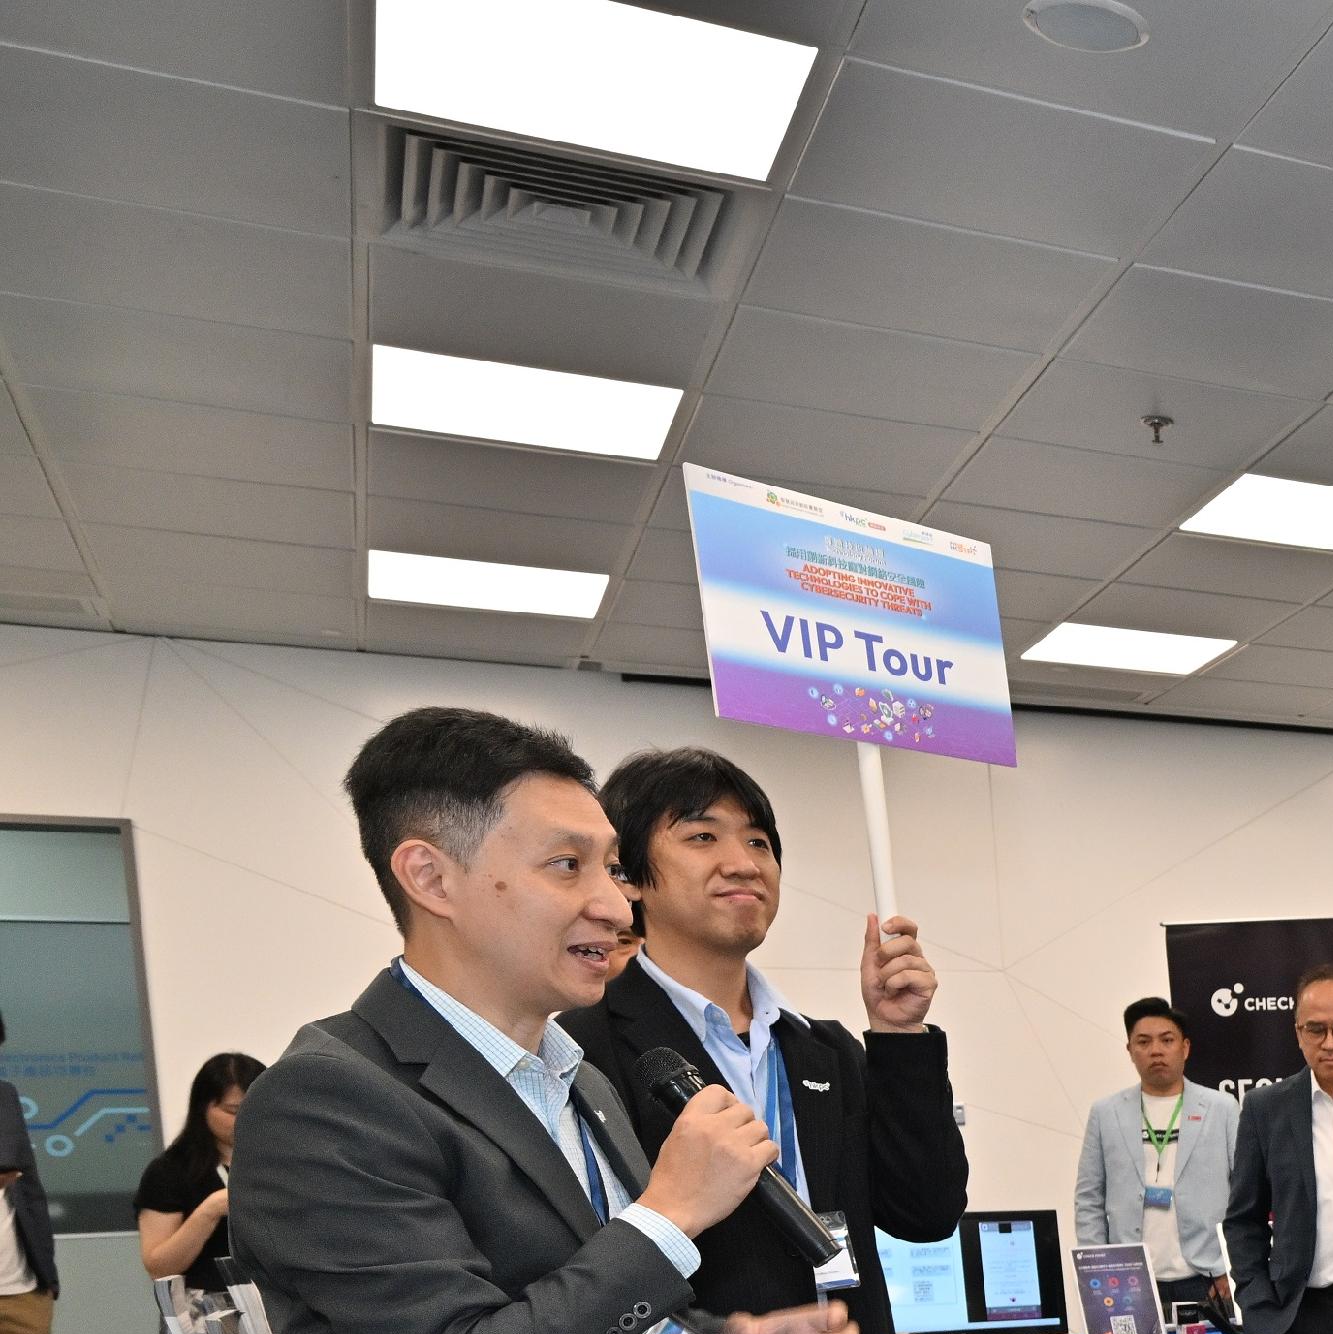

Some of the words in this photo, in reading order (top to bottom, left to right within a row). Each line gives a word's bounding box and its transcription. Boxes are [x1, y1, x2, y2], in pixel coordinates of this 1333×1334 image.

[786, 568, 862, 594] TECHNOLOGIES
[864, 587, 878, 598] TO
[880, 591, 905, 605] COPE
[906, 596, 932, 611] WITH
[801, 582, 879, 607] CYBERSECURITY
[880, 601, 923, 617] THREATS
[803, 564, 855, 582] ADOPTING
[858, 577, 914, 597] INNOVATIVE
[760, 610, 844, 662] VIP
[854, 630, 954, 686] Tour
